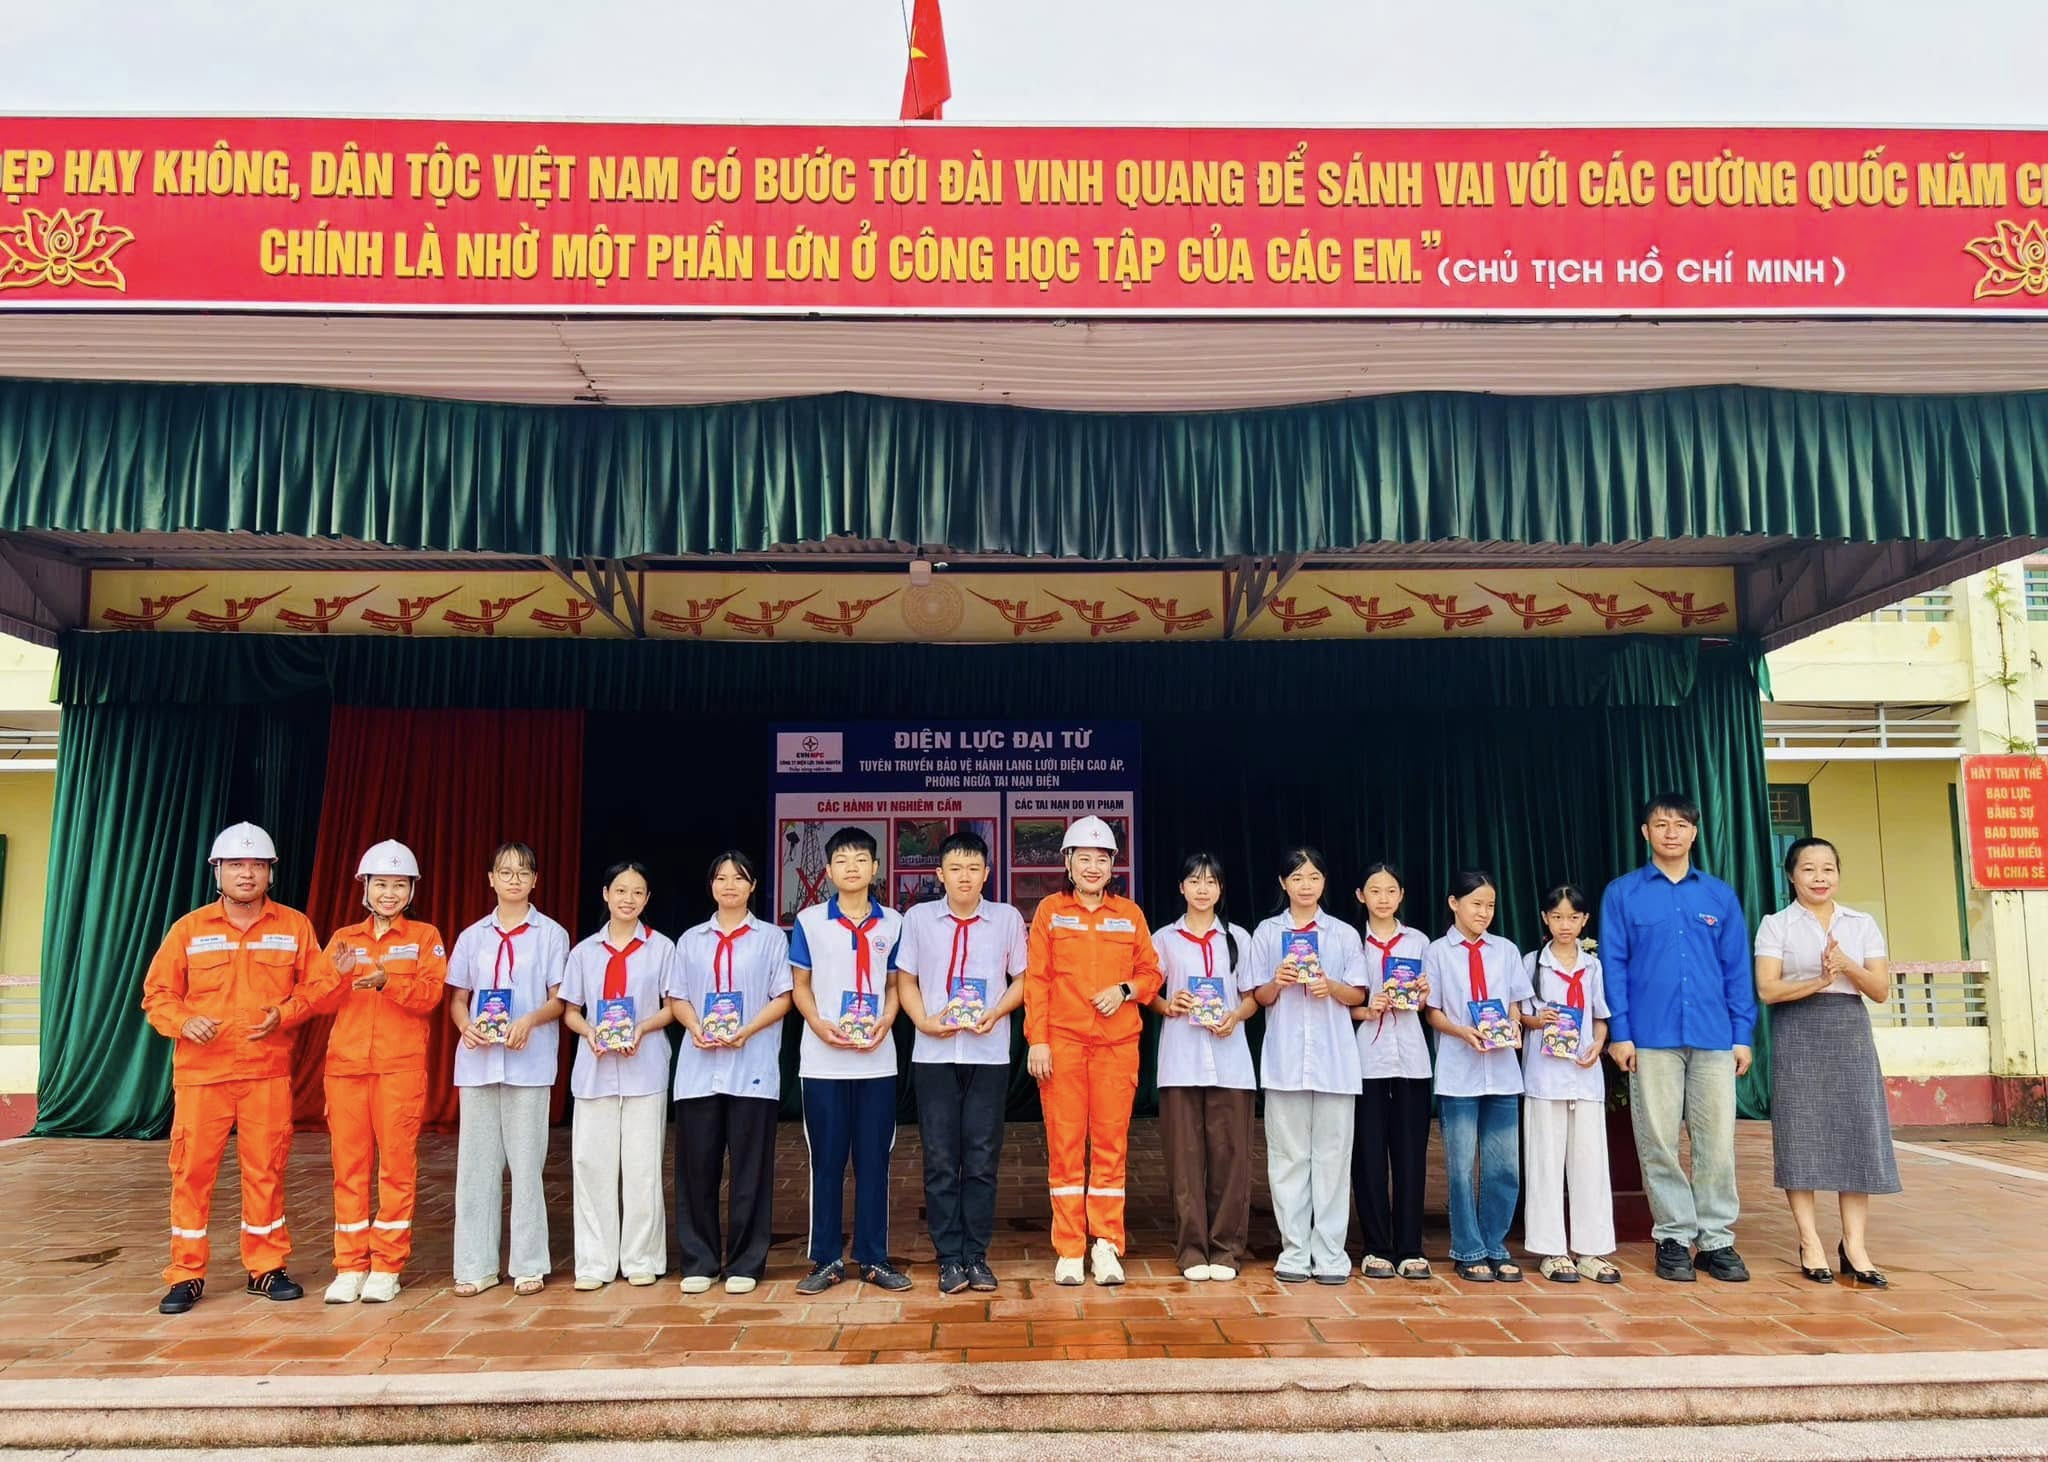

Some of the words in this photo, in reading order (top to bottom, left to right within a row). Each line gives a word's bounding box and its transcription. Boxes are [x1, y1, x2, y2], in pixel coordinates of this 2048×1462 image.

[0, 150, 54, 202] ẸP
[64, 150, 142, 193] HAY
[153, 140, 299, 199] KHÔNG,
[311, 142, 393, 195] DÂN
[406, 142, 479, 206] TỘC
[493, 145, 575, 207] VIỆT
[589, 157, 678, 199] NAM
[692, 147, 741, 200] CÓ
[755, 147, 855, 201] BƯỚC
[869, 149, 926, 201] TỚI
[939, 150, 1002, 202] ĐÀI
[1015, 160, 1103, 202] VINH
[1117, 160, 1244, 207] QUANG
[1257, 142, 1307, 204] ĐỂ
[1318, 152, 1422, 204] SÁNH
[1436, 162, 1494, 204] VAI
[1506, 151, 1567, 204] VỚI
[1580, 151, 1655, 204] CÁC
[1667, 150, 1797, 204] CƯỜNG
[1808, 146, 1908, 209] QUỐC
[1918, 152, 2007, 205] NĂM
[261, 220, 383, 275] CHÍNH
[395, 223, 443, 276] LÀ
[457, 222, 539, 277] NHỜ
[552, 224, 635, 286] MỘT
[647, 221, 752, 278] PHẦN
[766, 225, 839, 279] LỚN
[852, 220, 877, 279] Ở
[890, 226, 993, 280] CÔNG
[1006, 237, 1080, 289] HỌC
[1094, 228, 1165, 289] TẬP
[1179, 224, 1254, 281] CỦA
[1267, 229, 1341, 281] CÁC
[1438, 250, 1518, 286] (CHỦ
[1532, 259, 1603, 289] TỊCH
[1617, 246, 1663, 283] HỒ
[1677, 251, 1733, 283] CHÍ
[894, 728, 951, 752] ĐIỆN
[960, 729, 1005, 752] LỰC
[1013, 731, 1053, 752] ĐẠI
[1061, 727, 1093, 749] TỪ
[859, 757, 892, 772] TUYÊN
[936, 757, 957, 772] BẢO
[960, 757, 972, 773] VỆ
[975, 757, 1003, 772] HÀNH
[1006, 759, 1032, 772] LANG
[1060, 757, 1084, 773] ĐIỆN
[1087, 759, 1107, 772] CAO
[1110, 757, 1125, 772] ÁP,
[1995, 767, 2020, 779] THAY
[925, 773, 960, 787] PHÒNG
[994, 775, 1008, 787] TAI
[1011, 775, 1033, 789] NẠN
[1036, 773, 1060, 789] ĐIỆN
[2011, 786, 2031, 801] LỰC
[817, 799, 840, 813] CÁC
[843, 799, 874, 812] HÀNH
[877, 800, 887, 812] VI
[890, 798, 934, 812] NGHIÊM
[937, 796, 962, 812] CẤM
[1015, 798, 1032, 810] CÁC
[1035, 800, 1048, 810] TAI
[1051, 800, 1067, 811] NẠN
[1072, 800, 1084, 810] DO
[1087, 800, 1095, 810] VI
[1097, 800, 1124, 811] PHẠM
[2020, 806, 2035, 820] SỰ
[1984, 826, 2007, 839] BAO
[2010, 826, 2039, 839] DUNG
[1986, 864, 2000, 878] VÀ
[2003, 866, 2028, 878] CHIA
[2031, 862, 2045, 878] SẺ
